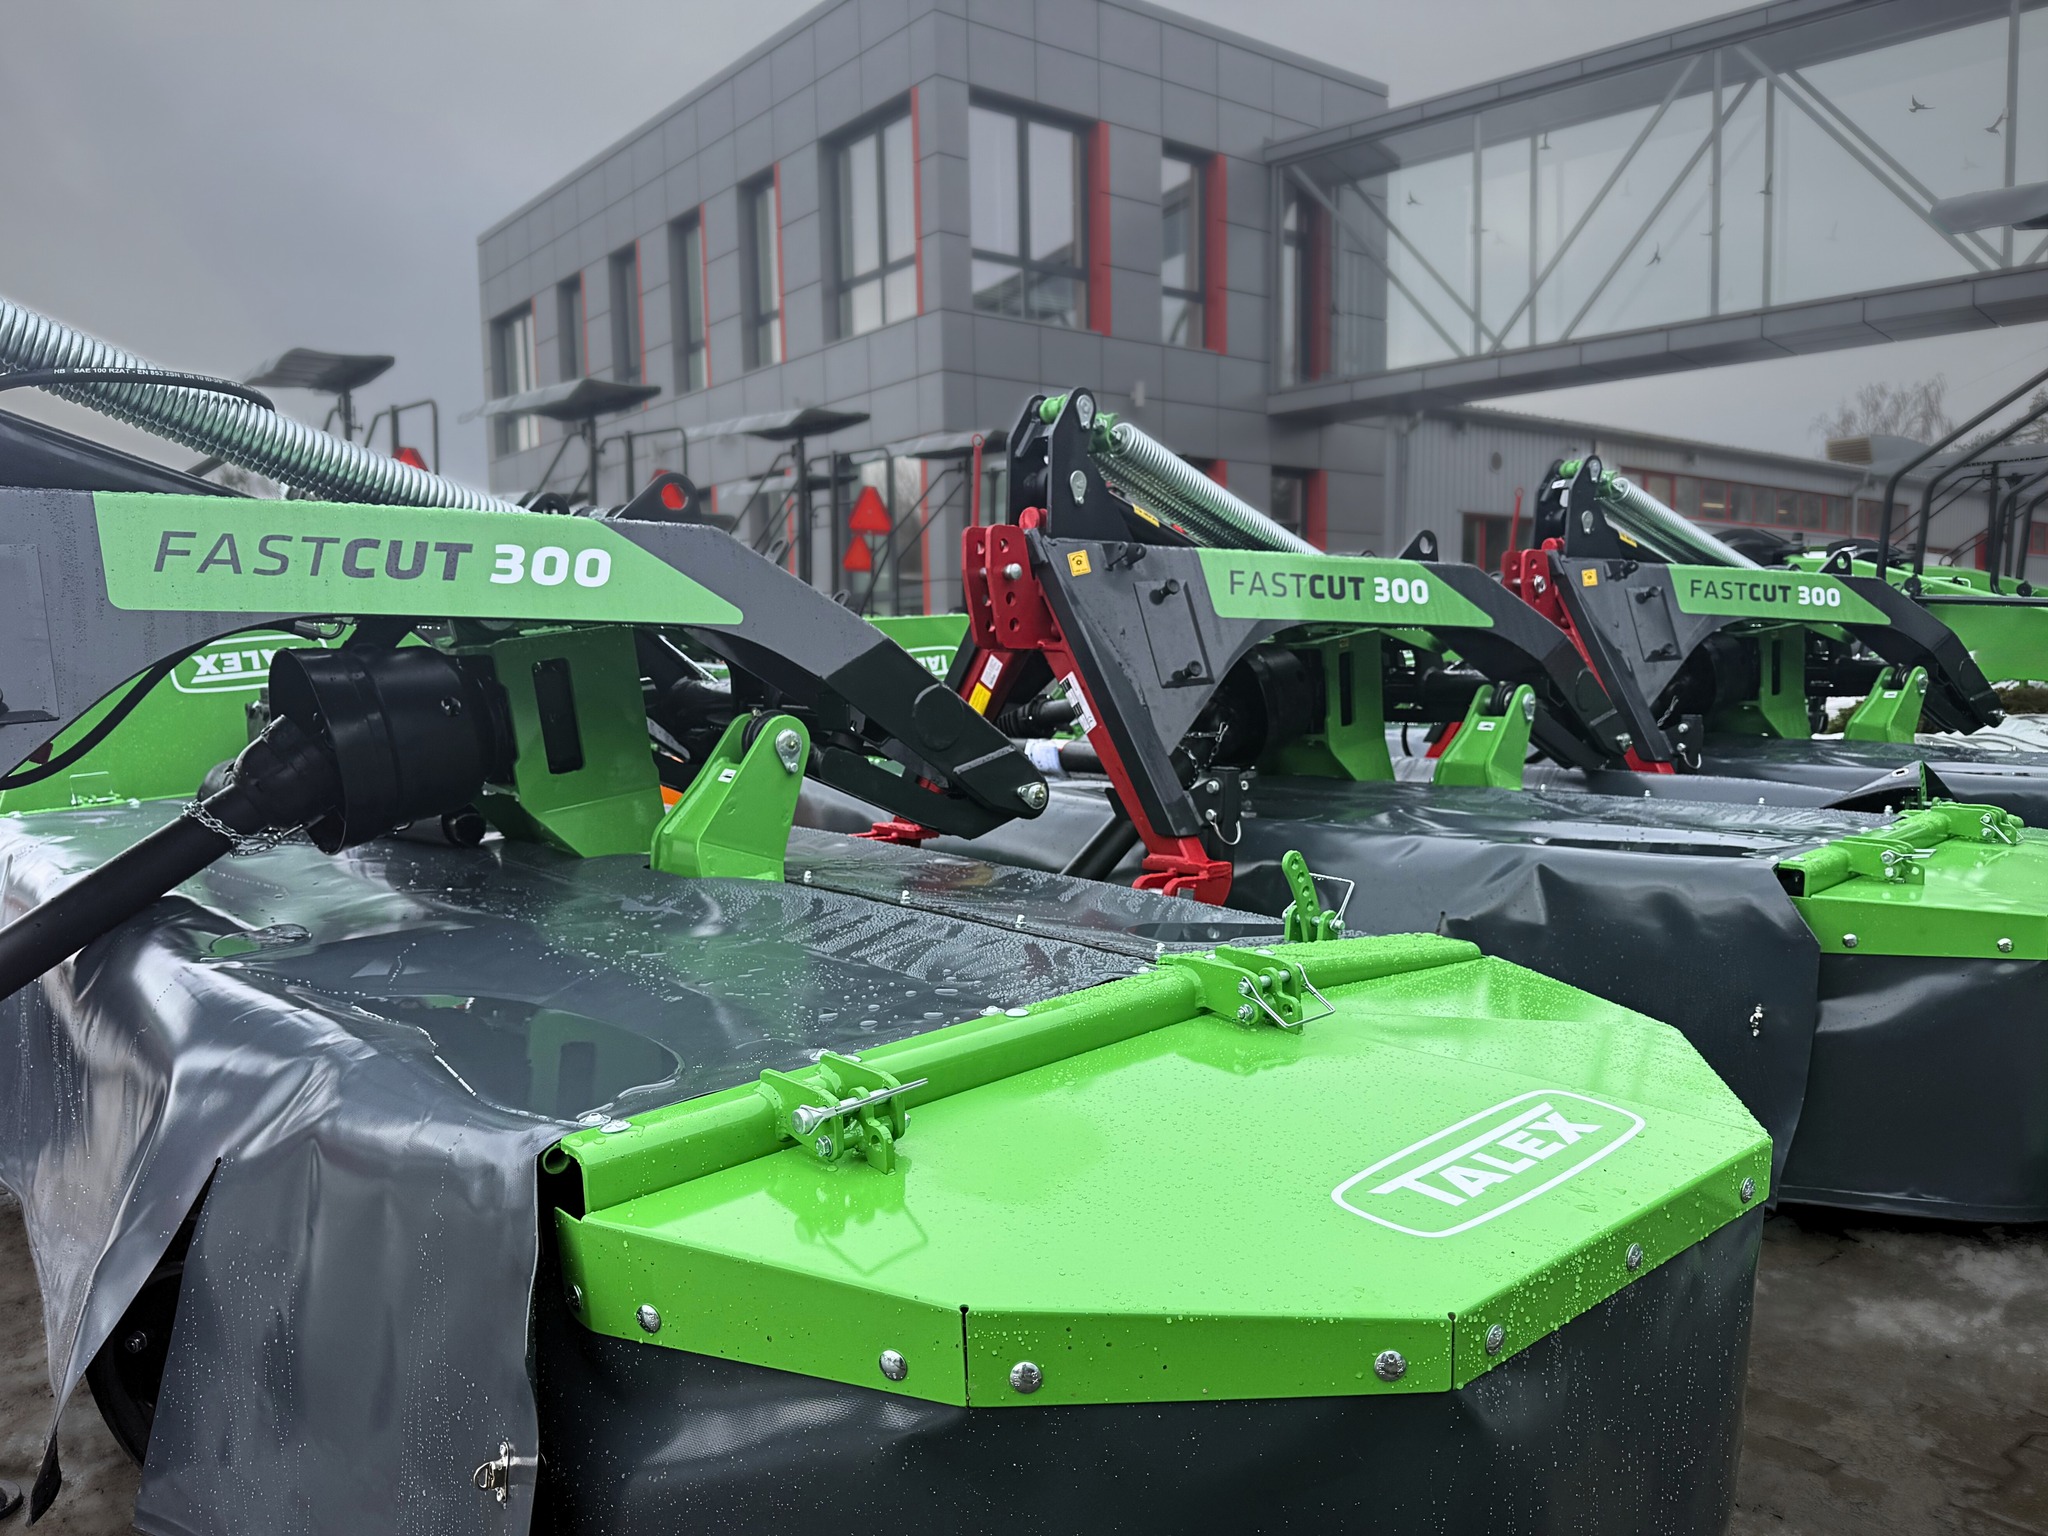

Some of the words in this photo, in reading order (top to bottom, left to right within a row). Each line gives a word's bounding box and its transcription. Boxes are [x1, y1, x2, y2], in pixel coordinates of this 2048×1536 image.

[153, 530, 474, 582] FASTCUT
[489, 543, 612, 588] 300
[1229, 569, 1365, 601] FASTCUT
[1373, 576, 1430, 605] 300
[1690, 579, 1792, 603] FASTCUT
[1797, 585, 1841, 607] 300
[1366, 1101, 1604, 1206] TALEX
